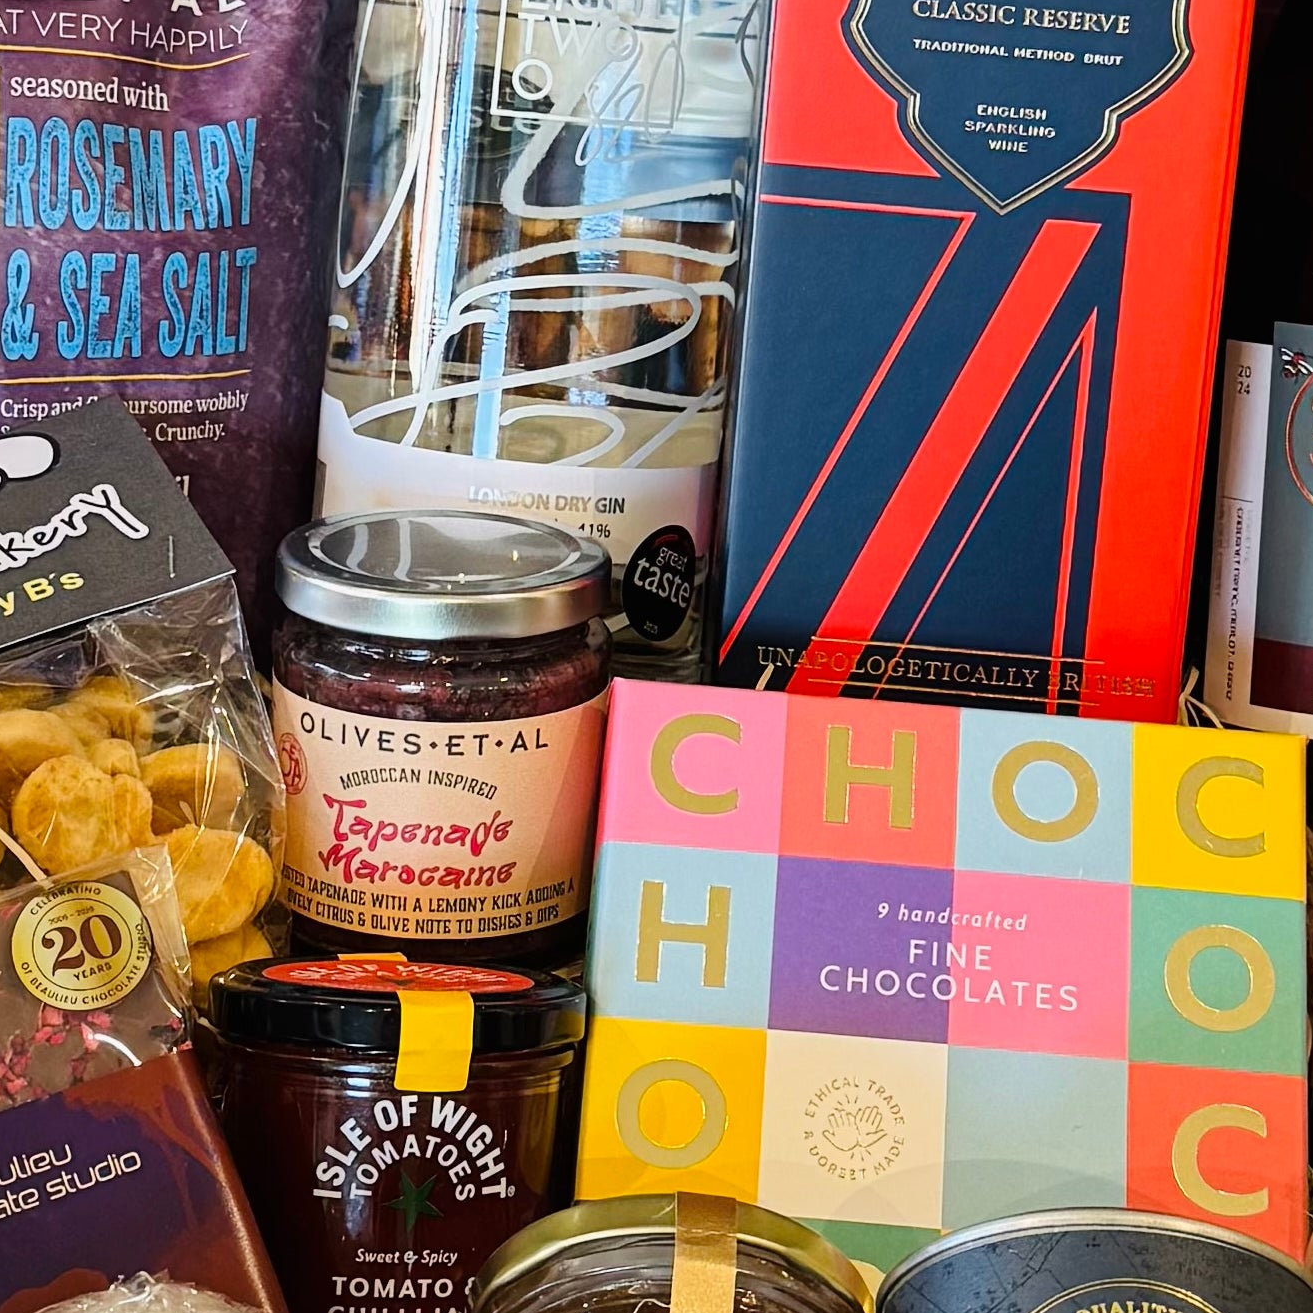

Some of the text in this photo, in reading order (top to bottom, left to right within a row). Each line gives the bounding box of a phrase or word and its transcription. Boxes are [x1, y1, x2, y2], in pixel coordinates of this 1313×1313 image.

[31, 10, 122, 44] VERY
[130, 18, 249, 56] HAPPILY
[912, 0, 1130, 34] CLASSIC RESERVE
[913, 39, 1008, 57] TRADITIONAL
[1014, 46, 1075, 62] METHOD
[10, 75, 170, 112] seasoned with
[977, 104, 1047, 121] ENGLISH
[964, 121, 1056, 138] SPARKLING
[988, 139, 1028, 154] WINE
[5, 116, 258, 234] ROSEMARY
[0, 246, 258, 360] & SEA SALT
[554, 495, 591, 513] DRY
[594, 497, 626, 515] GIN
[339, 768, 498, 800] MOROCCAN INSPIRED
[322, 793, 514, 856] Tapenade
[878, 903, 1027, 932] 9 handcrafted
[41, 913, 122, 977] 20
[909, 939, 993, 970] FINE
[819, 965, 1078, 1011] CHOCOLATES
[46, 1149, 143, 1202] studio
[332, 1276, 453, 1298] TOMATO
